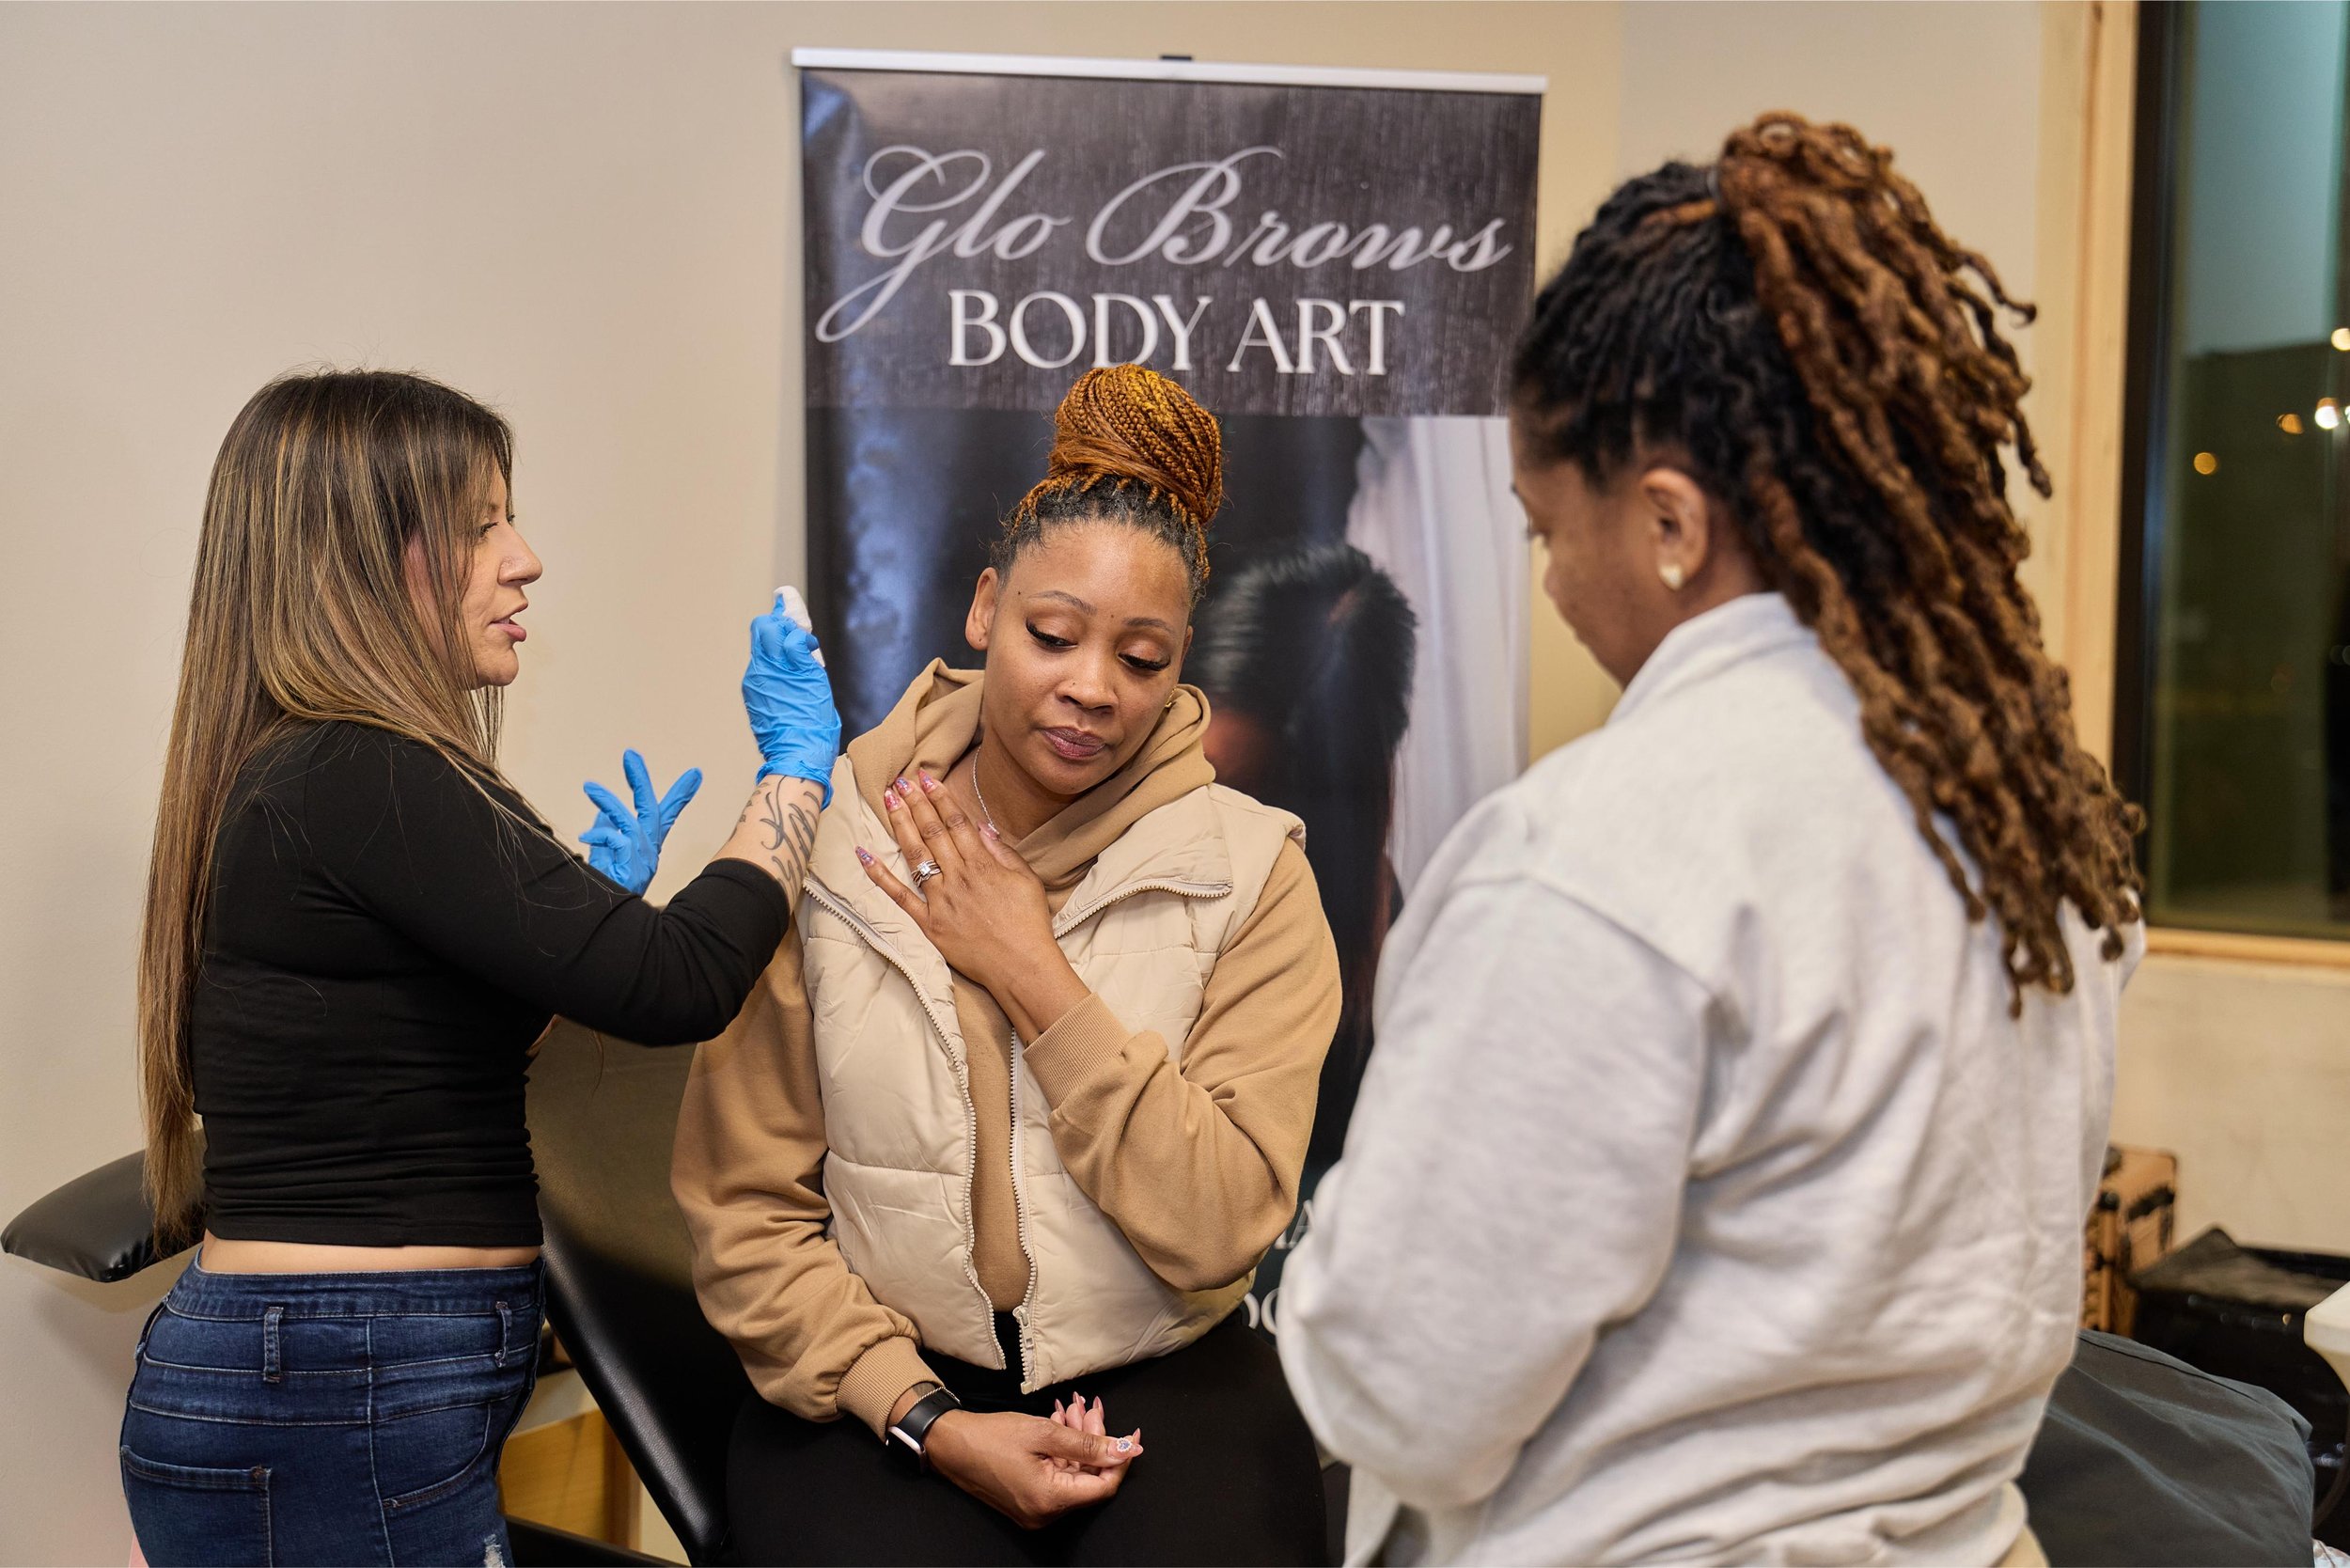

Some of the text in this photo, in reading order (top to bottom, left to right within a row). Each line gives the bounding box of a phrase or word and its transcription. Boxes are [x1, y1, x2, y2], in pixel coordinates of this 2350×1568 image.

[815, 144, 1513, 343] Glo Brows
[948, 289, 1406, 375] BODY ART
